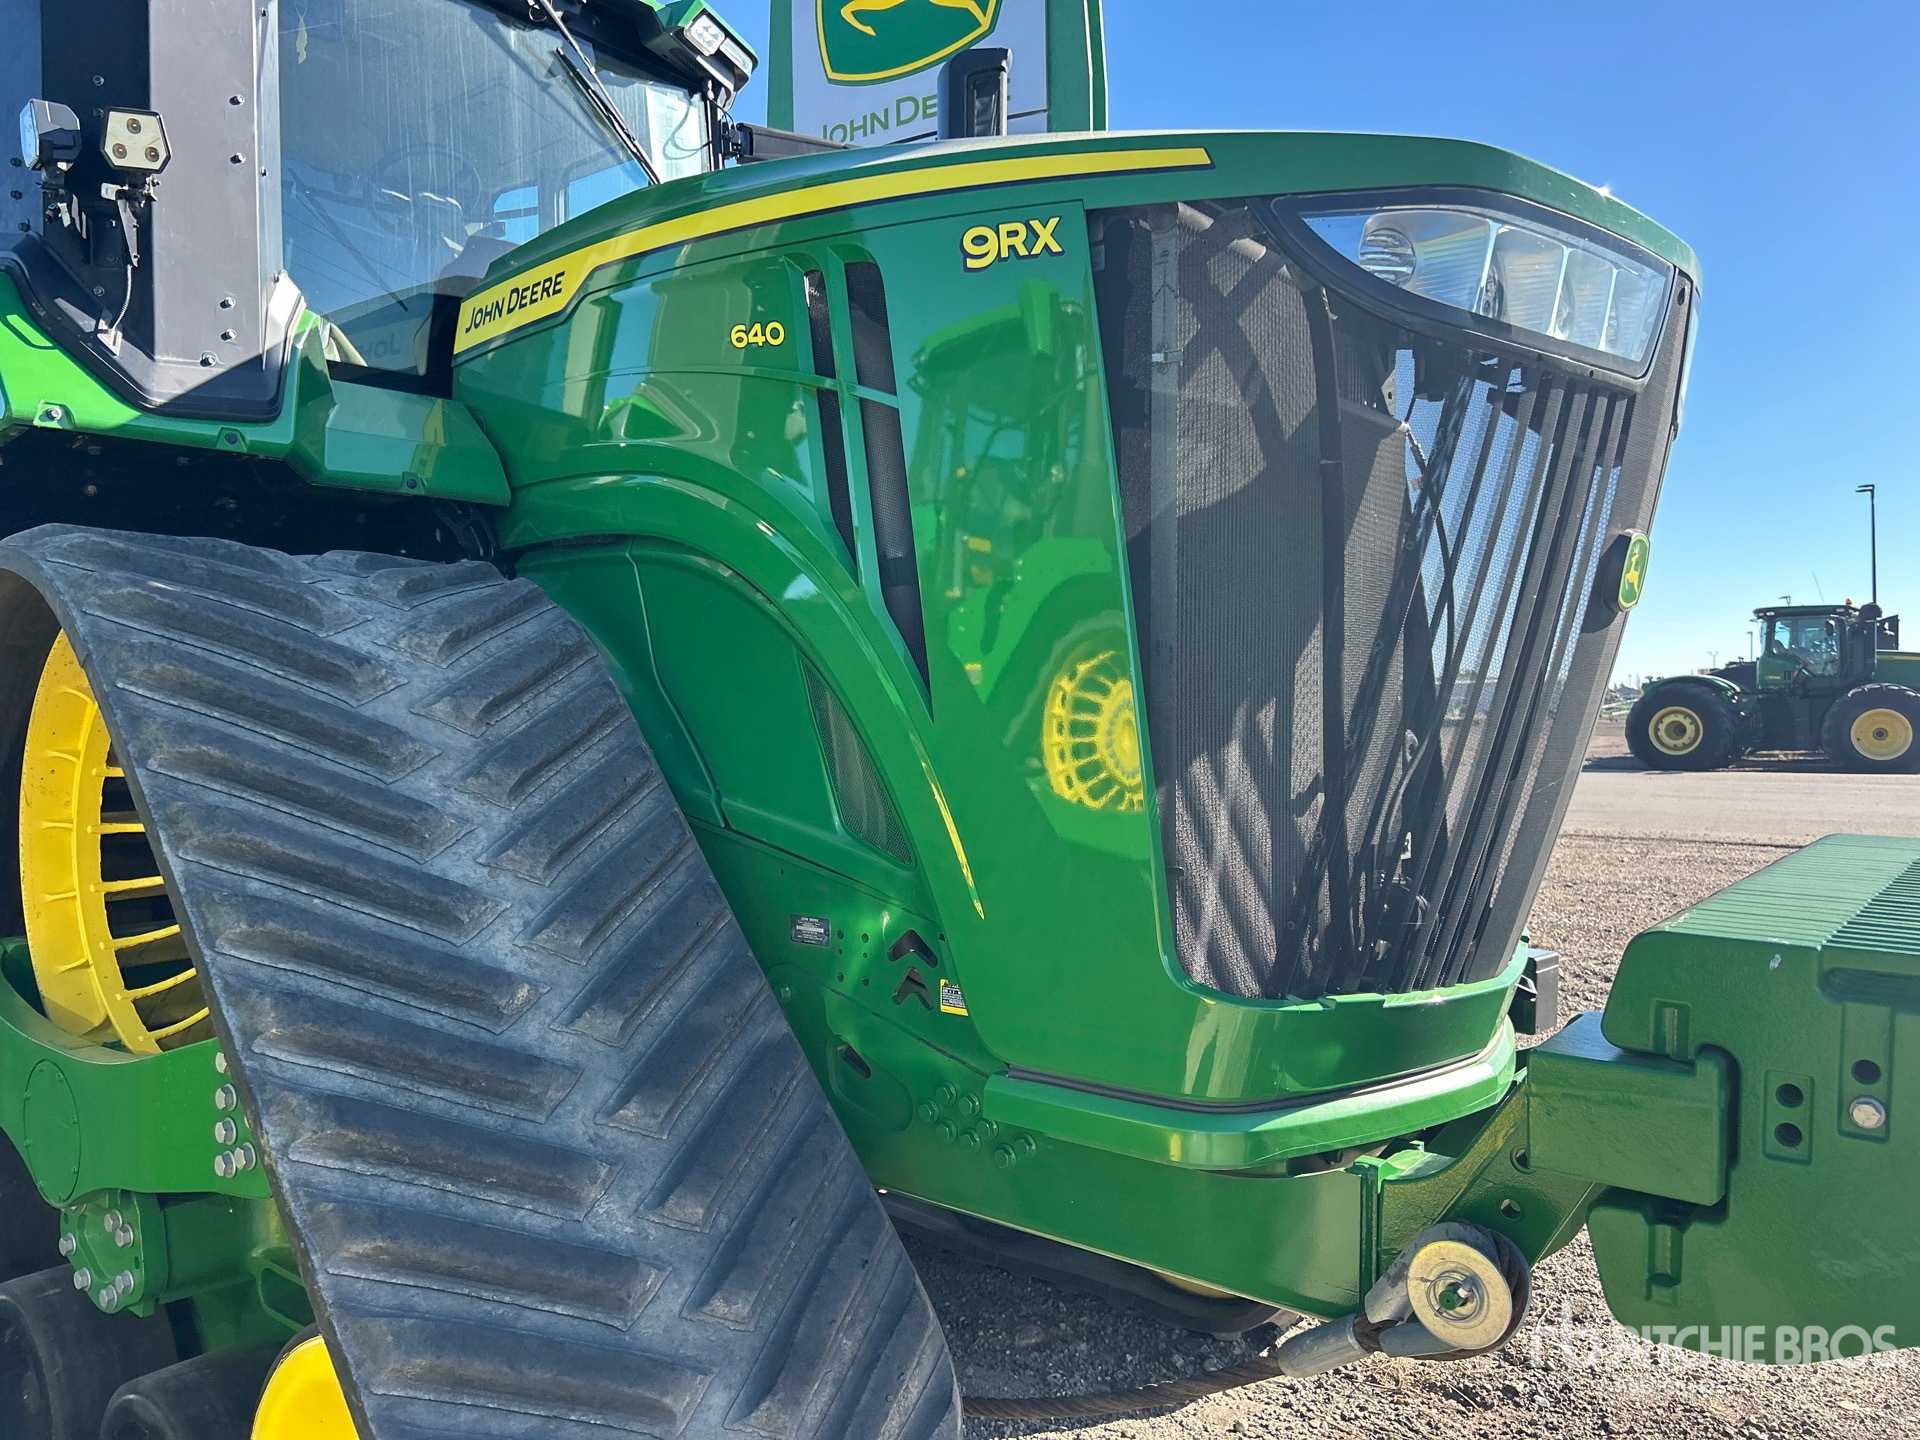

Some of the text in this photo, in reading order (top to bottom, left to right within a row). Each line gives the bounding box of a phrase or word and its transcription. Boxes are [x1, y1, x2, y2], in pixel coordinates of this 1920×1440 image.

[822, 107, 890, 144] JOHN
[960, 216, 1064, 271] 9RX
[465, 271, 565, 333] JOHN DEERE
[730, 320, 785, 349] 640
